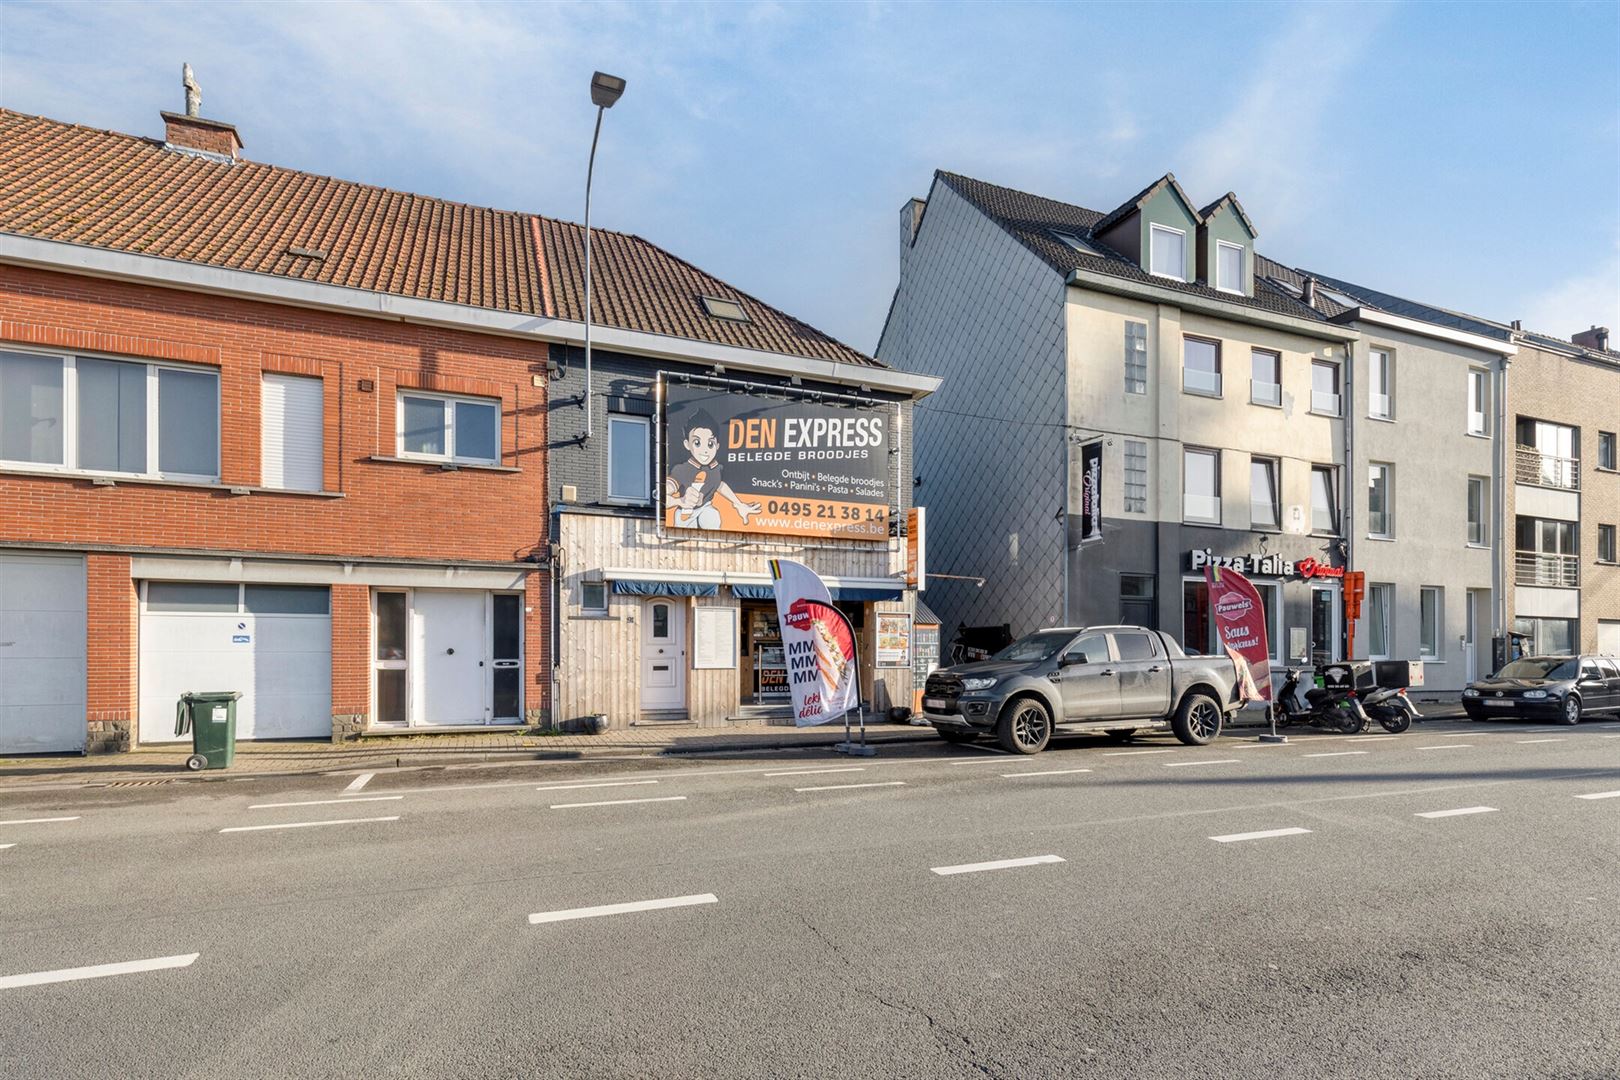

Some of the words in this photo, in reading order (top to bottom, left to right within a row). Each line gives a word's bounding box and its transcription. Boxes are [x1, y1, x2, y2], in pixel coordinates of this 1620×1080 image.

[728, 418, 777, 449] DEN
[783, 417, 883, 448] EXPRESS
[728, 451, 792, 462] BELEGDE
[798, 449, 869, 460] BROODJES
[751, 477, 783, 489] Snack's
[790, 481, 821, 492] Panini's
[827, 484, 849, 495] Pasta
[855, 487, 885, 498] Salades
[781, 469, 810, 482] Ontbijt
[817, 472, 850, 485] Belegde
[850, 475, 885, 488] broodjes
[767, 500, 812, 517] 0495
[816, 504, 837, 519] 21
[841, 506, 861, 521] 38
[865, 508, 885, 523] 14
[755, 516, 885, 535] www.denexpress.be
[1191, 547, 1245, 573] Pizza
[1300, 556, 1345, 580] Original
[1218, 600, 1249, 612] Pauwels
[1224, 625, 1250, 640] Saus
